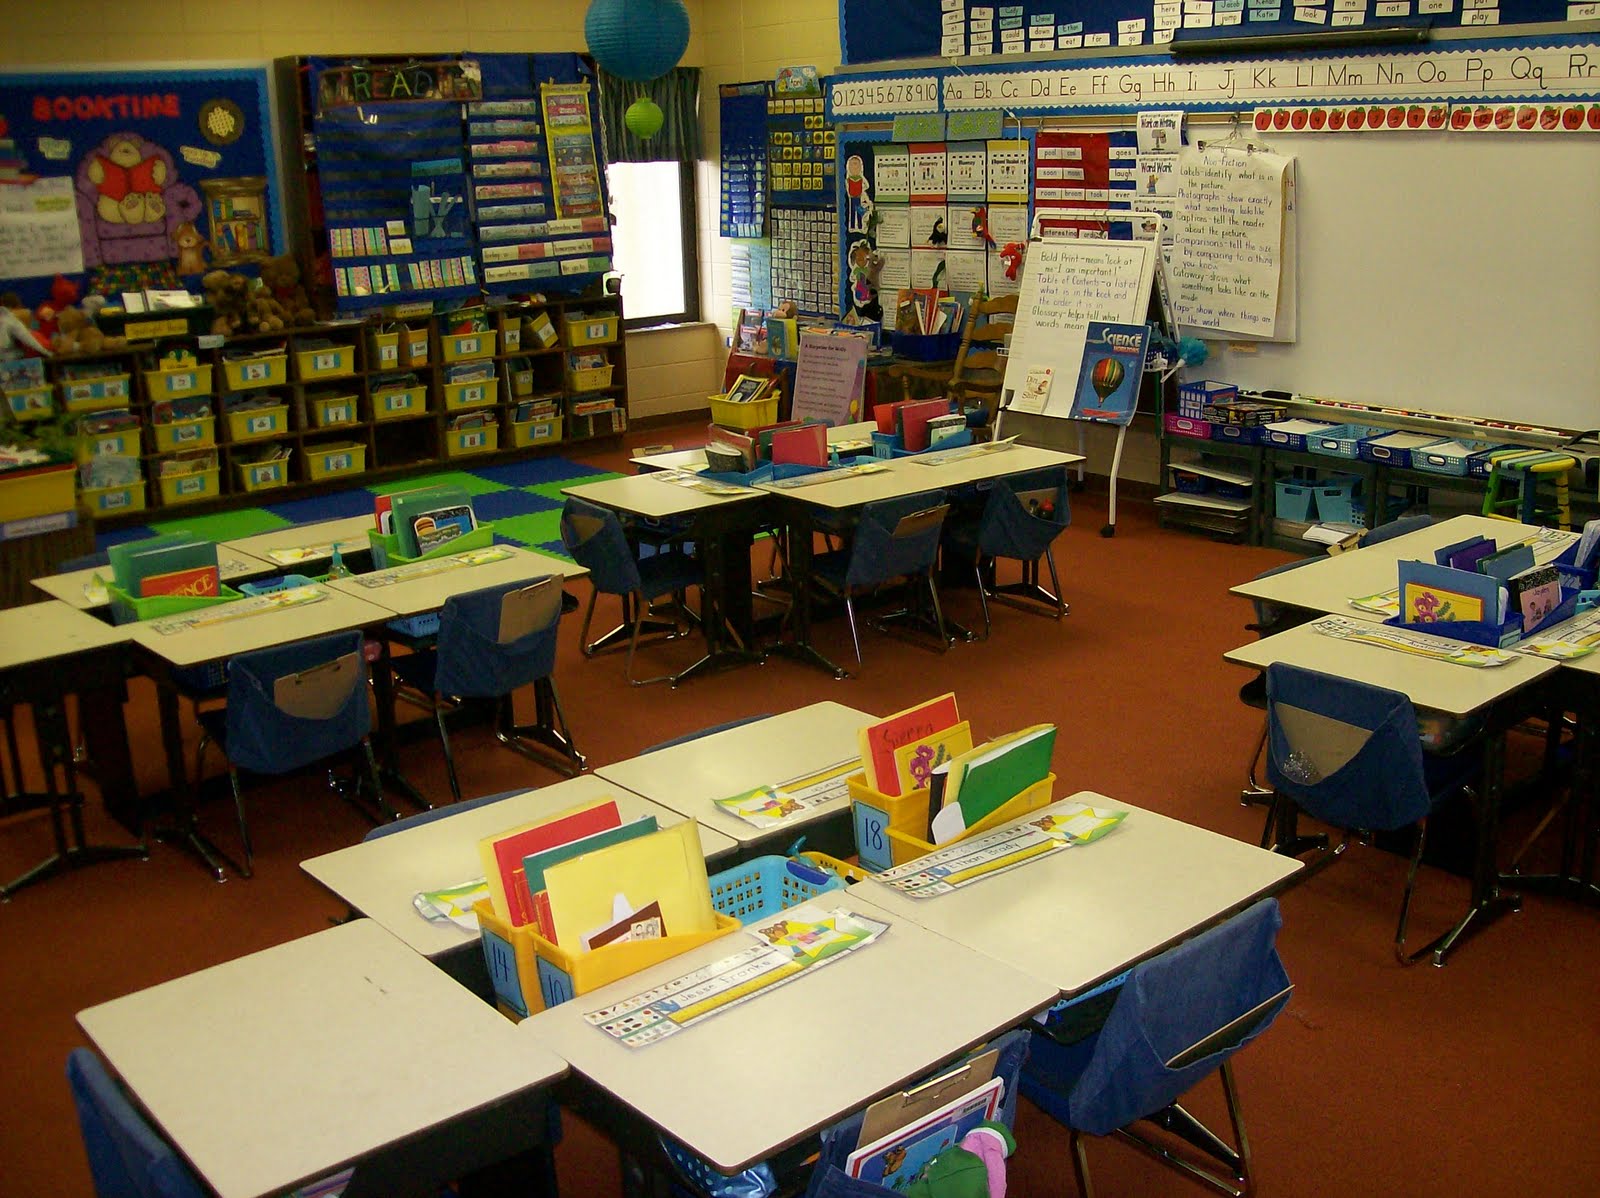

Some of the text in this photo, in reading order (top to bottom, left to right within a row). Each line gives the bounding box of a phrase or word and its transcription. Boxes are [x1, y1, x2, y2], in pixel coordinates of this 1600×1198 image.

[1256, 10, 1273, 19] Katie
[1303, 7, 1317, 18] look
[1579, 5, 1596, 15] red
[1161, 18, 1176, 26] have
[1221, 15, 1237, 26] jump
[1342, 16, 1353, 26] my
[1471, 9, 1489, 24] play
[1034, 27, 1050, 35] down
[1127, 23, 1138, 33] get
[1005, 30, 1020, 38] could
[1092, 34, 1102, 42] for
[1129, 37, 1136, 45] go
[946, 54, 1598, 102] Aa Bb Cc Dd Ee Ff Gg Hh Ii Jj Kk Ll Mm Nn Oo Pp Qq Rr
[353, 71, 433, 99] READ
[33, 93, 181, 120] BOOKTIME
[1141, 118, 1152, 128] Work
[1569, 114, 1577, 123] 16
[825, 148, 833, 156] 17
[1044, 149, 1057, 159] pool
[1115, 150, 1132, 159] goes
[803, 165, 810, 173] 22
[1141, 161, 1172, 173] Word Work
[1114, 169, 1133, 181] laugh
[1238, 170, 1255, 180] what
[814, 180, 822, 188] 30
[1188, 179, 1199, 188] the
[1227, 193, 1244, 203] show
[1247, 196, 1272, 207] exactly
[1184, 202, 1201, 211] what
[1205, 203, 1235, 216] something
[1254, 206, 1265, 216] like
[1229, 215, 1239, 226] the
[1242, 218, 1265, 228] reader
[1184, 223, 1205, 234] about
[1208, 225, 1218, 236] the
[1245, 241, 1255, 251] the
[1040, 251, 1058, 262] Bold
[1061, 252, 1079, 263] Print
[1183, 247, 1273, 267] by comparing to thing
[1182, 261, 1195, 269] you
[1037, 273, 1137, 289] Table of Contents list of
[1232, 273, 1251, 285] what
[1039, 286, 1059, 295] what
[1083, 288, 1093, 297] the
[1096, 288, 1111, 299] book
[1114, 291, 1128, 299] and
[1181, 283, 1270, 299] something looks like the
[1039, 297, 1049, 305] the
[1086, 310, 1099, 320] tell
[1102, 313, 1120, 322] what
[1196, 304, 1213, 315] show
[1218, 308, 1235, 318] where
[1240, 310, 1259, 323] things
[1035, 319, 1085, 330] words mean
[1187, 315, 1220, 327] the world
[864, 817, 883, 851] 18
[946, 843, 1022, 869] Ethan Brady
[493, 941, 508, 982] 14
[680, 983, 715, 1002] Jesse
